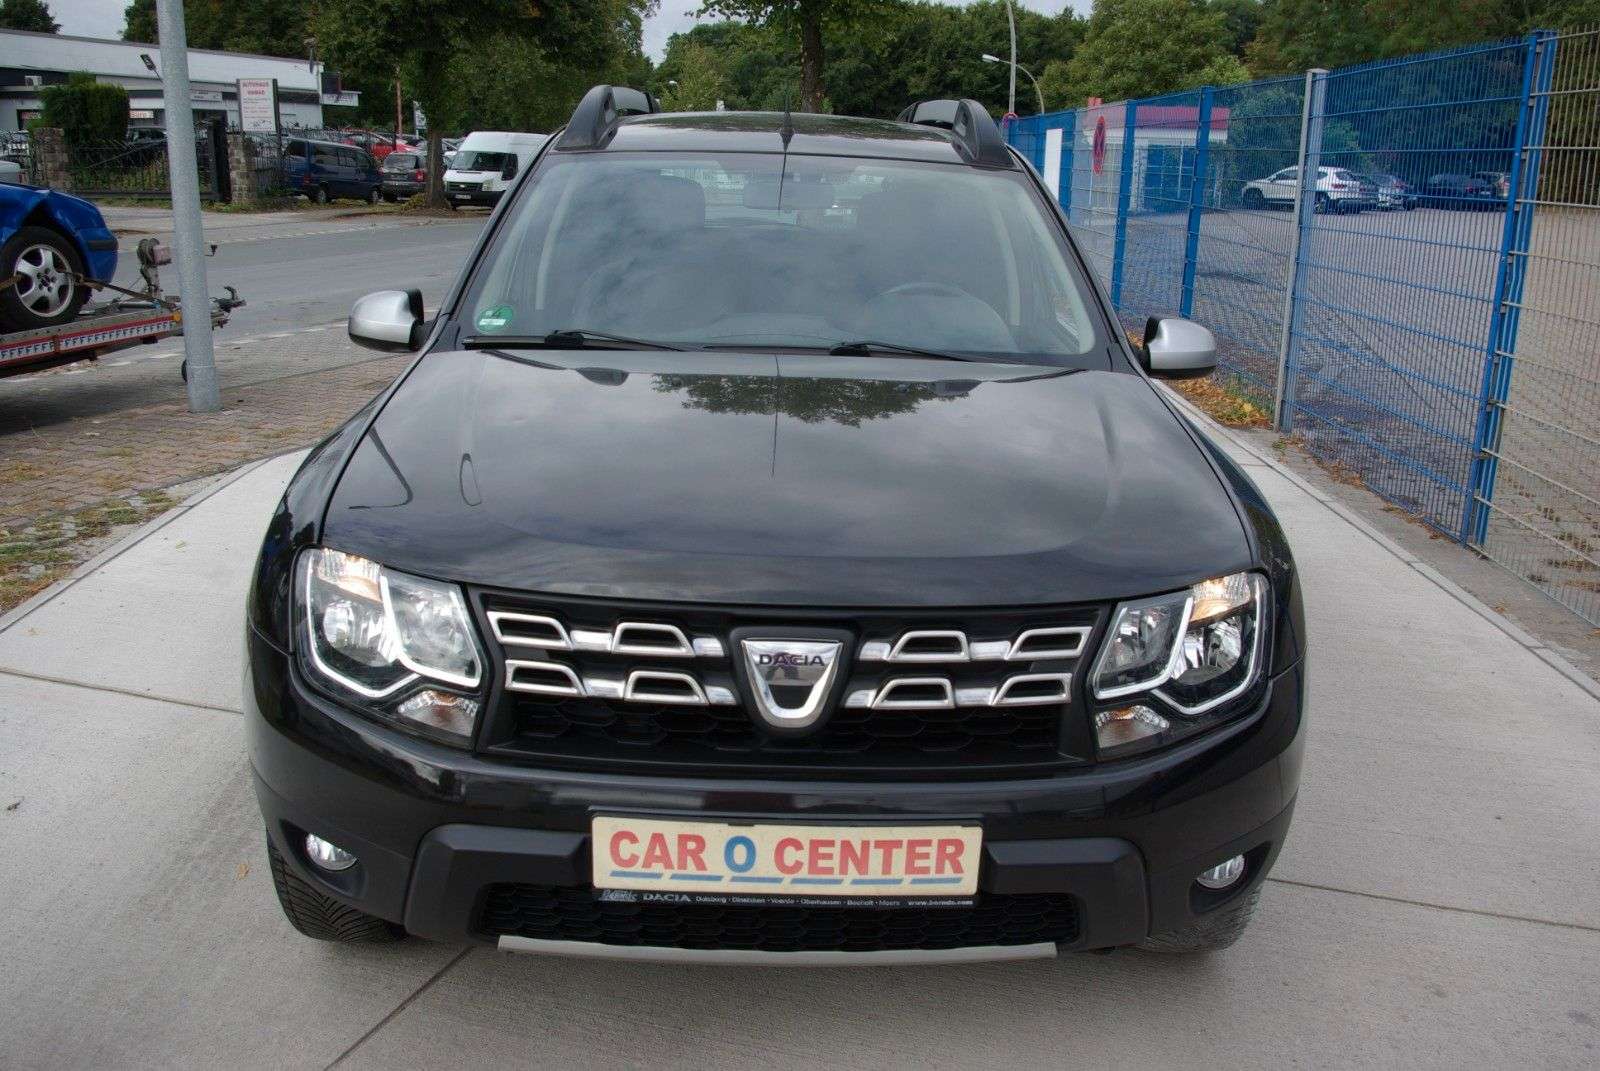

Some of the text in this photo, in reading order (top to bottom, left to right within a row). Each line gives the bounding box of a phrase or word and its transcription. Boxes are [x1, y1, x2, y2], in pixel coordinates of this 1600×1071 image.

[759, 654, 825, 666] DACIA
[609, 830, 966, 876] CAR O CENTER
[642, 892, 691, 902] DACIA
